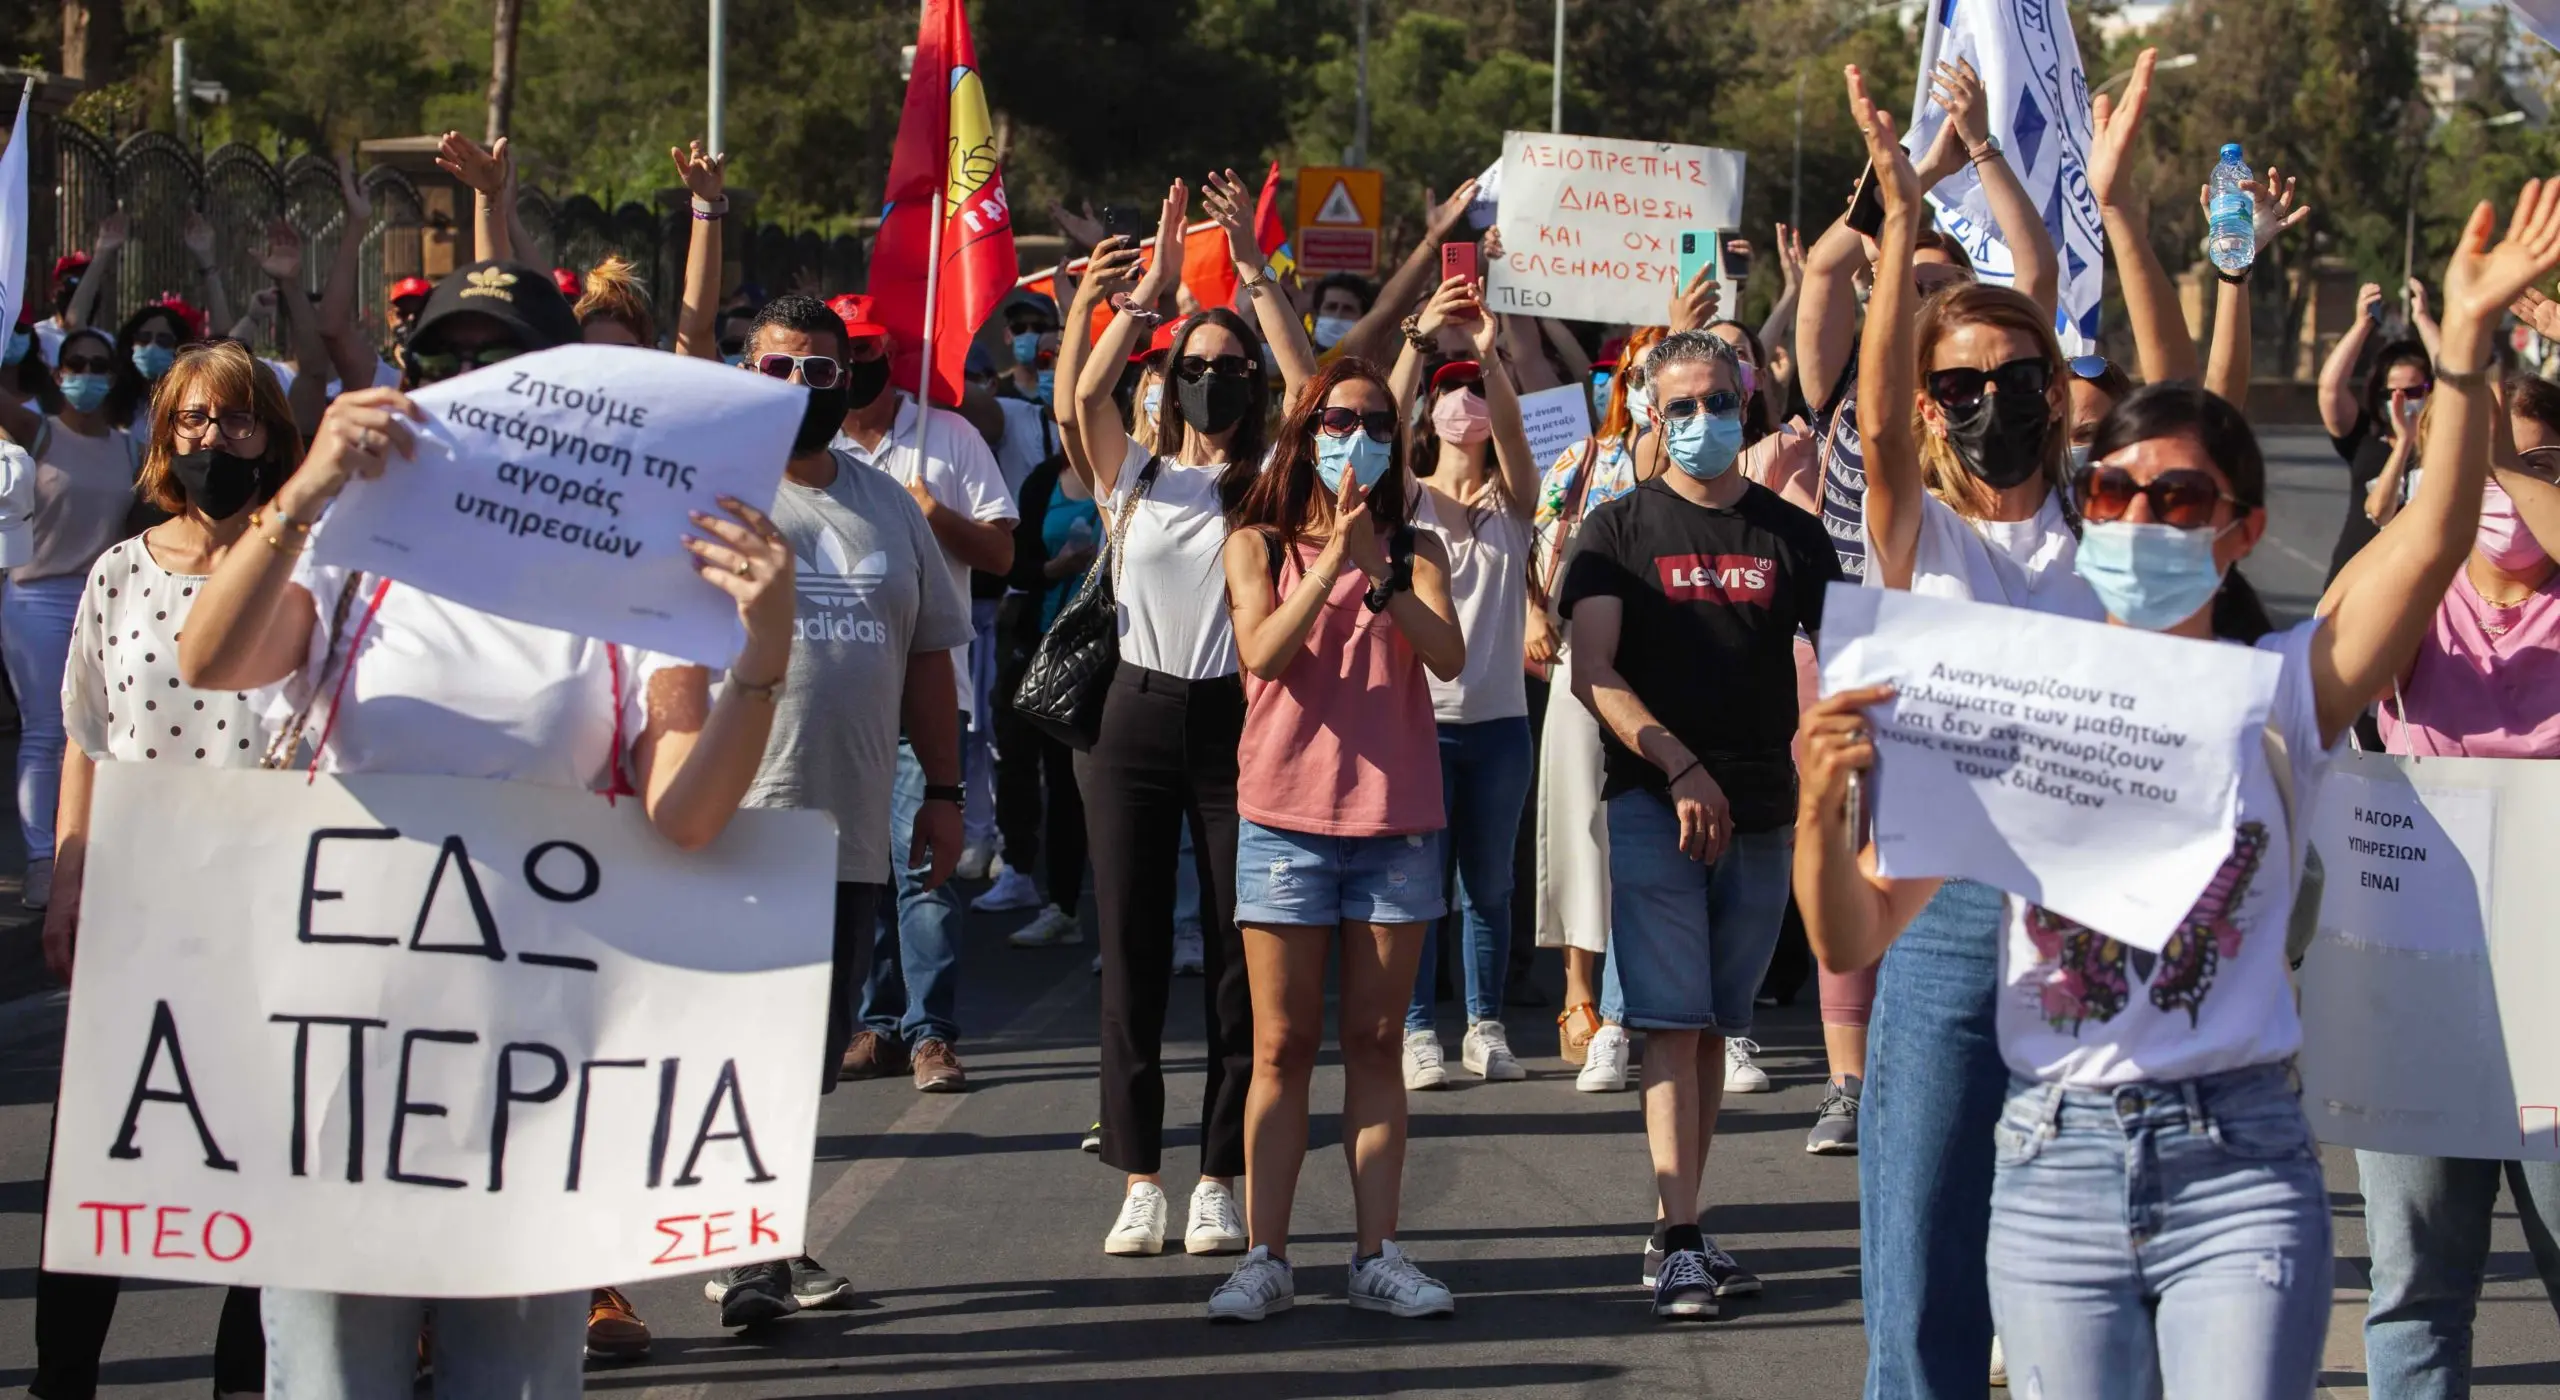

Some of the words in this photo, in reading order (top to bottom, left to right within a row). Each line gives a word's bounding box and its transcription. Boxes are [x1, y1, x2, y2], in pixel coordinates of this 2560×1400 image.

[1522, 146, 1707, 186] ΑΞΙΟΠΡΕΠΗΣ
[1560, 186, 1693, 220] ΔΙΑΒΙΩΣΗ
[1539, 224, 1582, 248] ΚΑΙ
[1623, 232, 1675, 254] ΟΧΙ
[1498, 286, 1552, 307] ΠΕΟ
[507, 371, 648, 429] Ζητούμε
[448, 401, 632, 476] κατάργηση
[643, 452, 697, 491] της
[496, 462, 625, 517] αγοράς
[454, 491, 643, 559] υπηρεσιών
[1929, 661, 2103, 706] Αναγνωρίζουν
[2110, 692, 2136, 711] τα
[1897, 711, 1934, 731] και
[1941, 711, 1982, 736] δεν
[1989, 723, 2163, 773] αναγνωρίζουν
[2024, 702, 2068, 727] των
[2073, 713, 2186, 748] μαθητών
[1939, 739, 2124, 795] εκπαιδευτικούς
[2130, 781, 2177, 804] που
[1954, 759, 2006, 787] τους
[2012, 773, 2105, 809] δίδαξαν
[2355, 806, 2362, 821] Η
[2365, 810, 2414, 829] ΑΓΟΡΑ
[2348, 836, 2426, 861] ΥΠΗΡΕΣΙΩΝ
[298, 827, 600, 972] ΕΔΩ
[2361, 871, 2399, 892] ΕΙΝΑΙ
[79, 1202, 253, 1263] ΠΕΟ
[650, 1208, 780, 1265] ΣΕΚ
